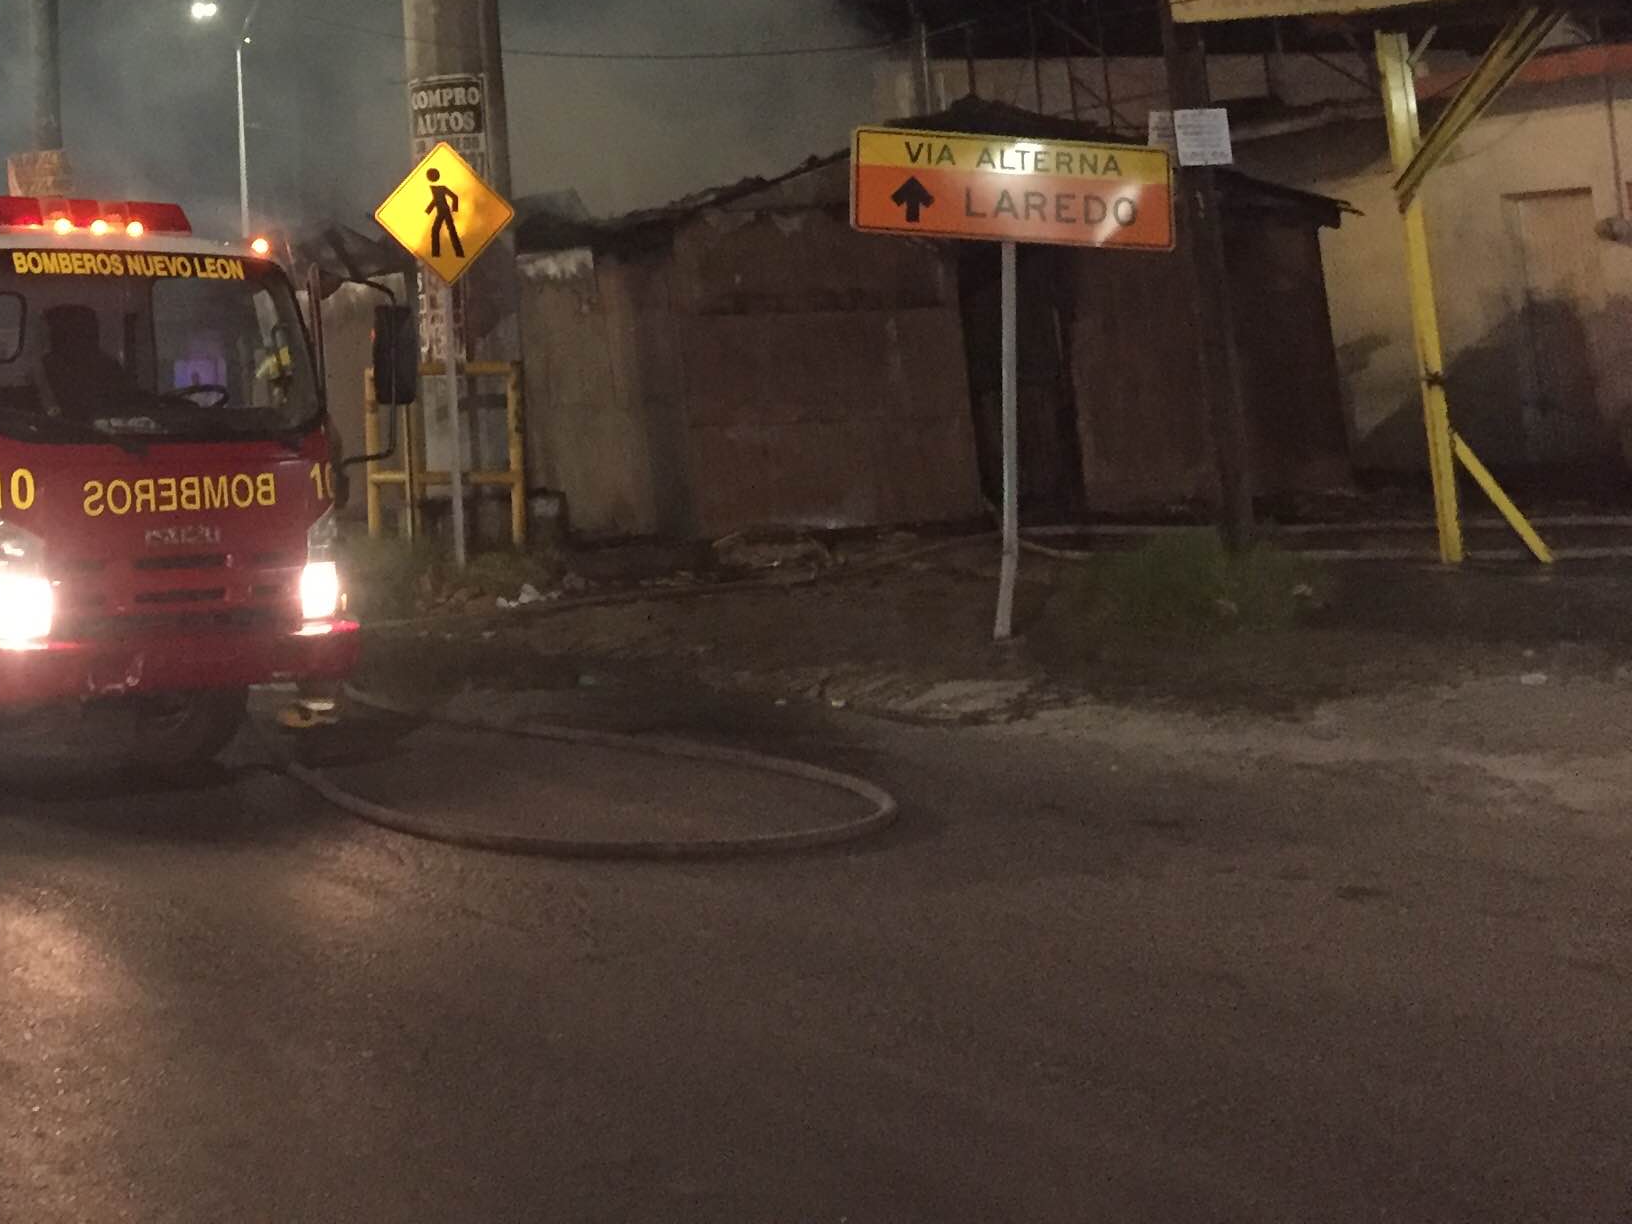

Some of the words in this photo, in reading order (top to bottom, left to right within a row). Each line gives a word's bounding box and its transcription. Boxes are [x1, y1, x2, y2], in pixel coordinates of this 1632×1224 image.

[412, 86, 480, 110] COMPRO
[417, 111, 475, 135] AUTOS
[905, 141, 956, 166] VIA
[976, 146, 1122, 176] ALTERNA
[965, 187, 1137, 225] LAREDO
[12, 252, 123, 276] BOMBEROS
[126, 254, 191, 276] NUEVO
[194, 257, 244, 280] LEON
